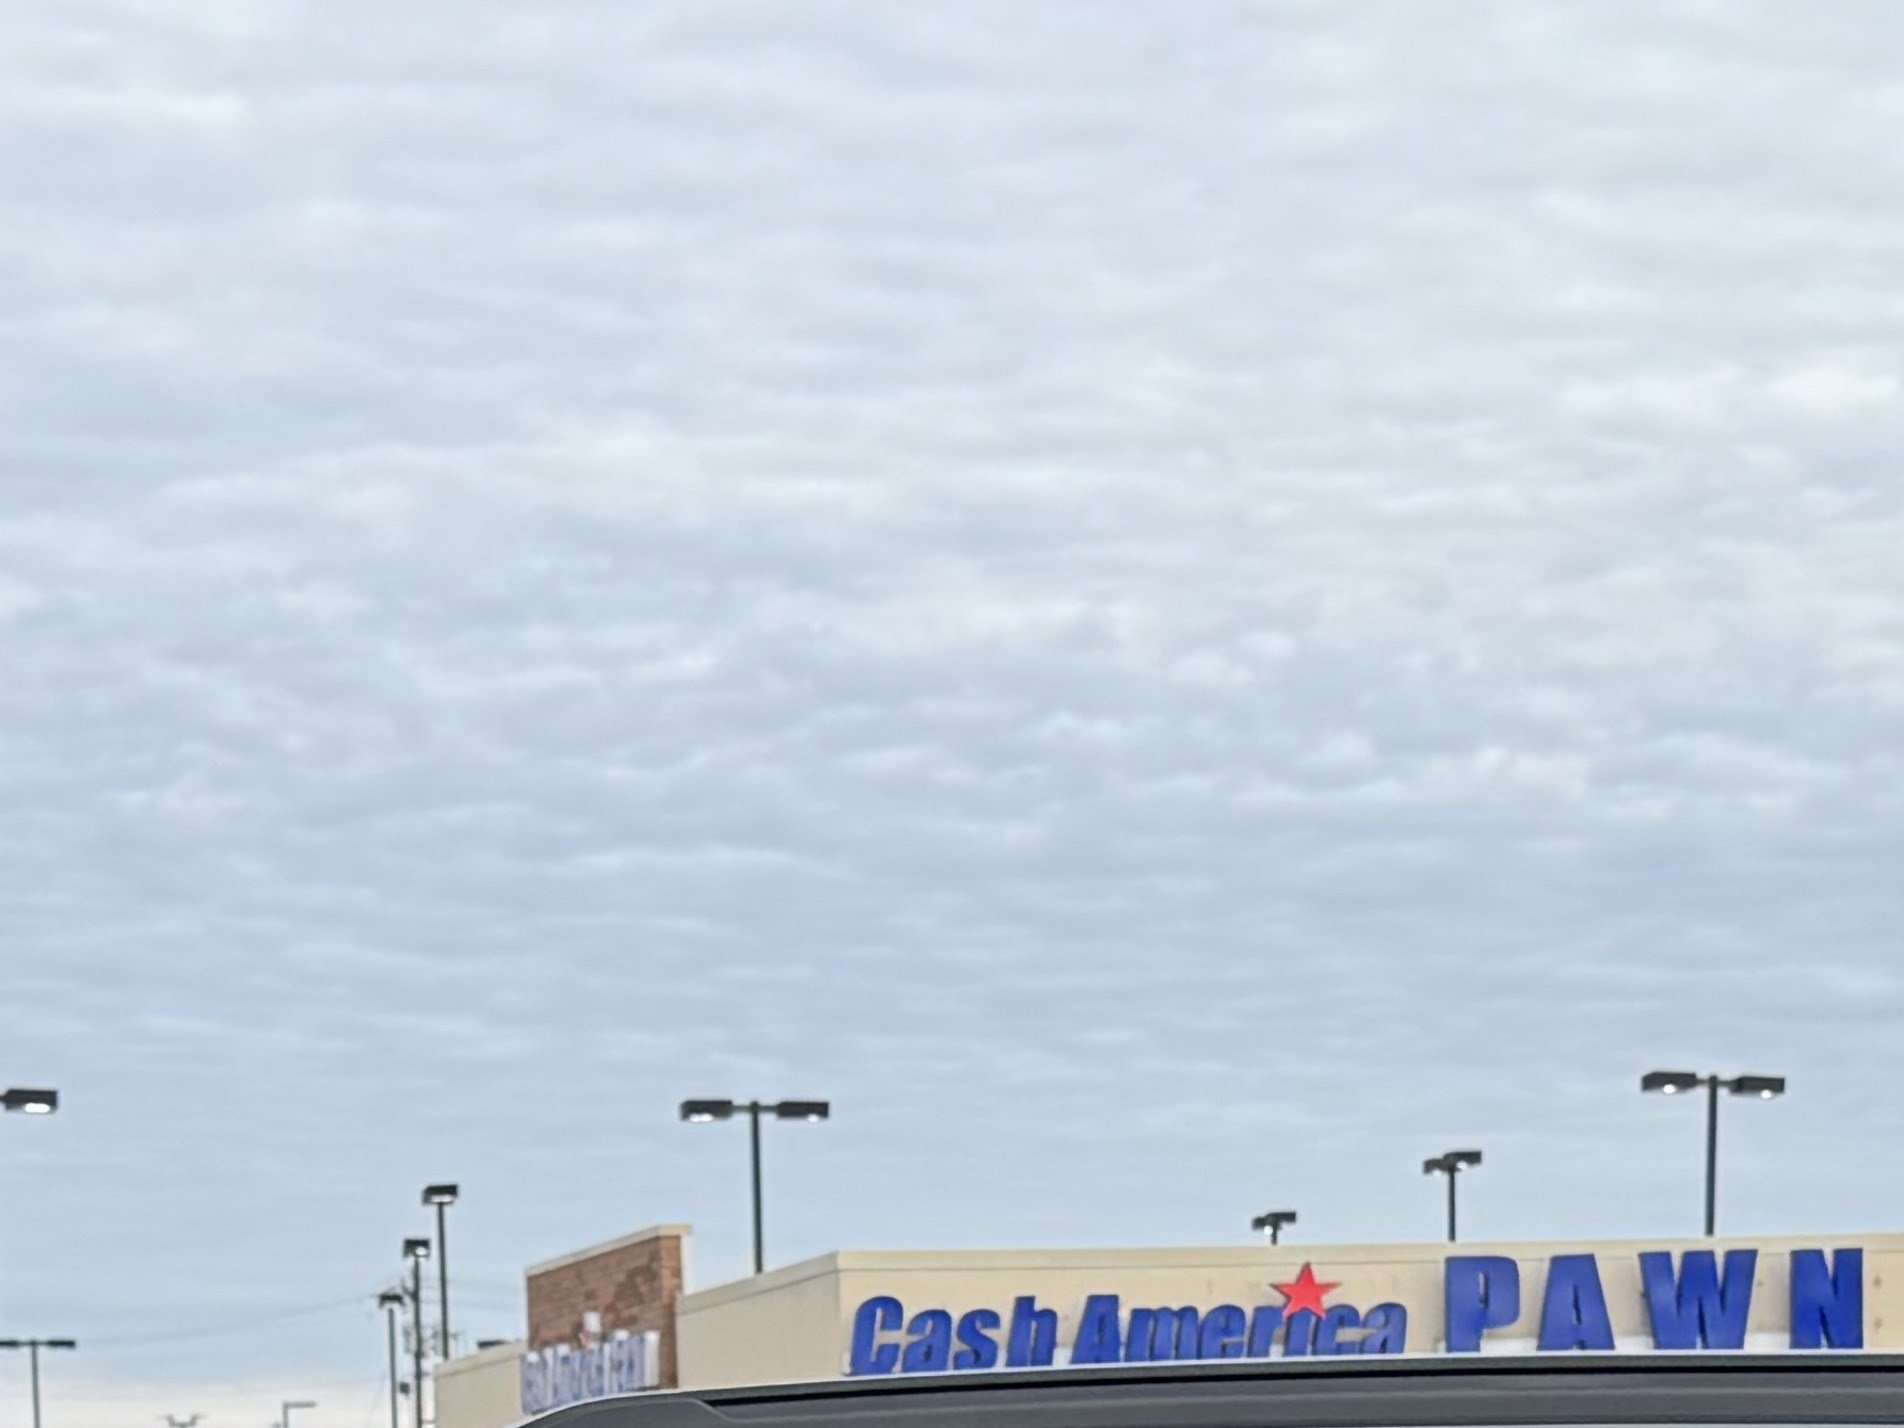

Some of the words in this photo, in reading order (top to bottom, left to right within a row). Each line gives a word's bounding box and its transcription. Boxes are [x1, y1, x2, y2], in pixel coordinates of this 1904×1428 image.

[848, 1295, 1059, 1376] Cash
[1070, 1294, 1408, 1365] America
[1444, 1247, 1864, 1353] PAWN
